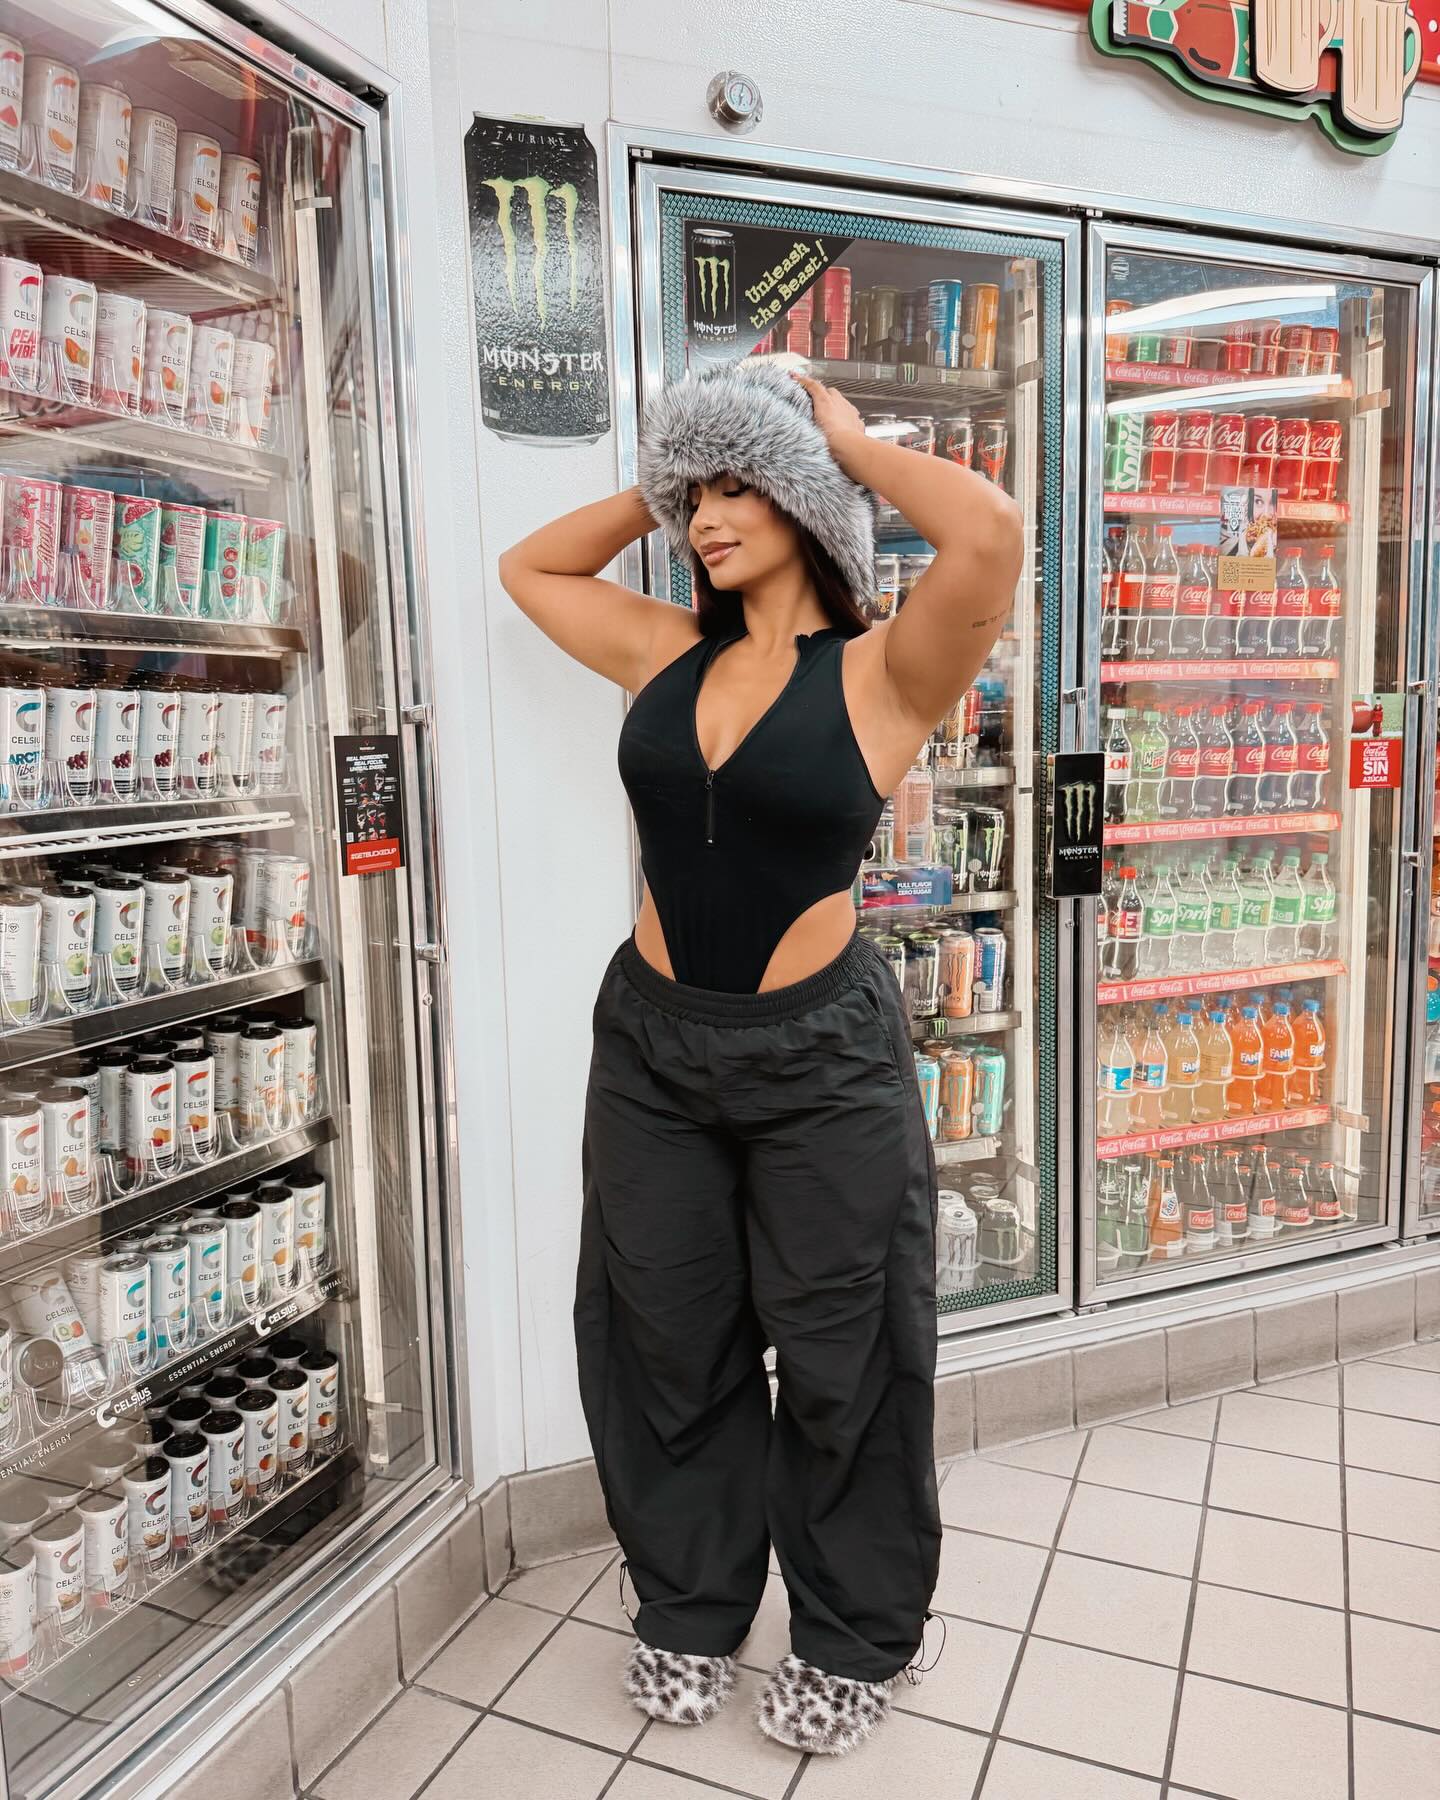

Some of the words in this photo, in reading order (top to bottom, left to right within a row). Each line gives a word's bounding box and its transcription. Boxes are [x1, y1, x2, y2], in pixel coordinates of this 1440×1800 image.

[496, 131, 568, 147] TAURINE
[744, 240, 811, 304] Unleash
[749, 300, 783, 330] the
[693, 319, 738, 336] MONSTER
[482, 344, 604, 376] MONSTER
[498, 376, 595, 392] ENERGY
[1363, 761, 1389, 776] SIN
[1058, 846, 1099, 857] MONSTER
[912, 888, 932, 896] SUGAR
[268, 1302, 298, 1325] CELSIUS
[168, 1355, 209, 1382] ESSENTIAL
[209, 1337, 237, 1359] ENERGY
[113, 1386, 153, 1414] CELSIUS
[37, 1431, 73, 1459] ENERGY
